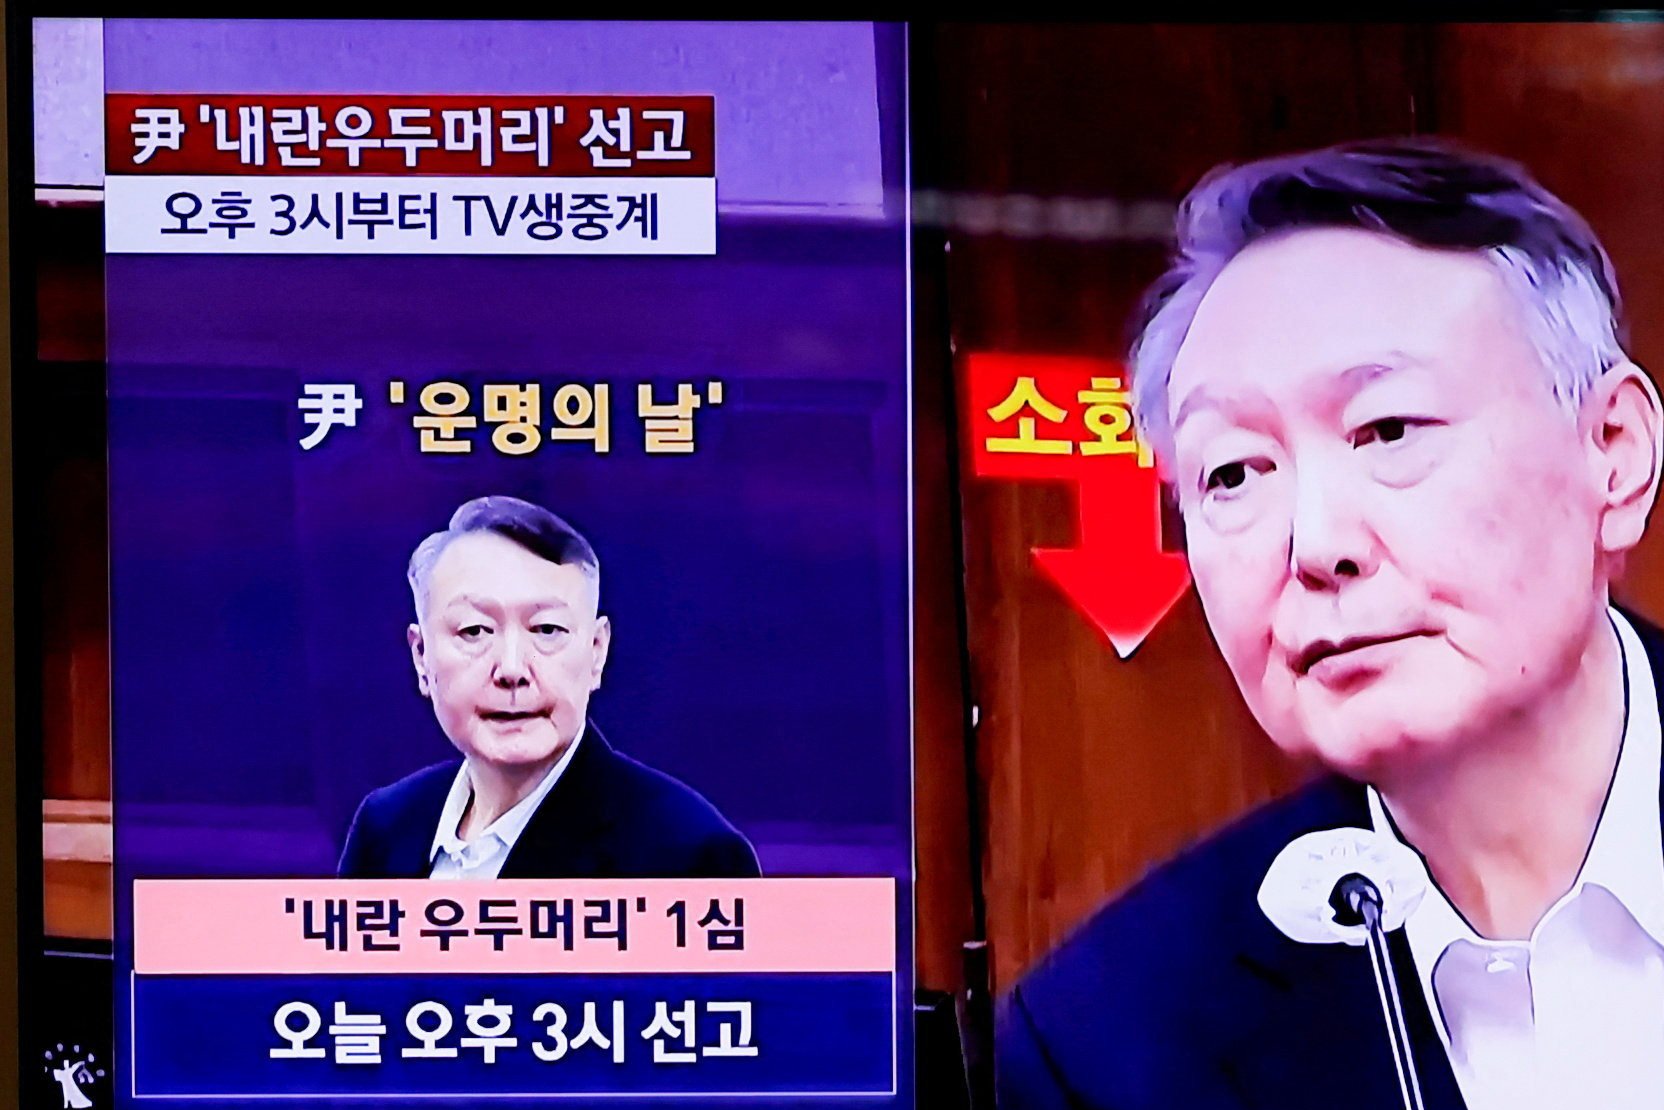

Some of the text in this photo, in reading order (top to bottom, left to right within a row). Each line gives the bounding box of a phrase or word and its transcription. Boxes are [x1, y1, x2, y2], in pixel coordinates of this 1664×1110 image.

[131, 105, 690, 166] 尹 '내란우두머리' 선고
[161, 192, 657, 240] 오후 3시부터 TV생중계
[298, 382, 722, 454] 尹 '운명의 날'
[286, 897, 744, 951] '내란 우두머리' 1심
[270, 999, 758, 1063] 오늘 오후 3시 선고
